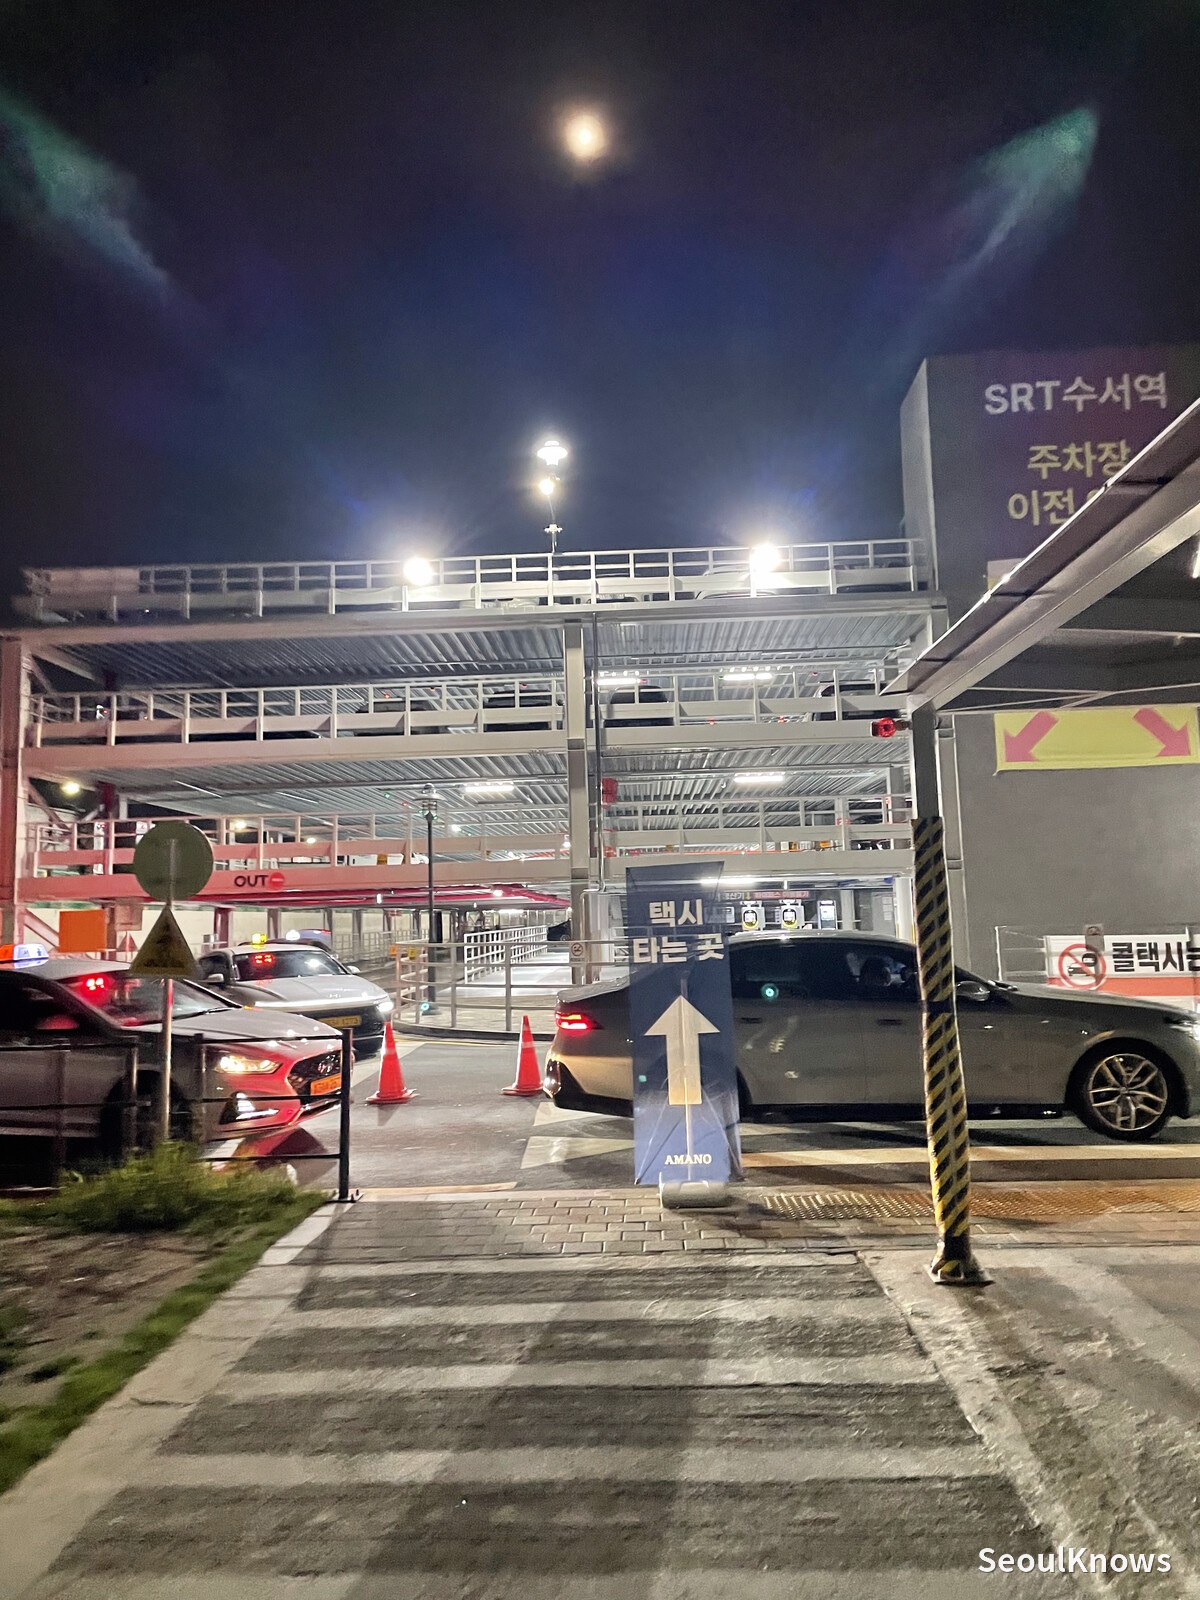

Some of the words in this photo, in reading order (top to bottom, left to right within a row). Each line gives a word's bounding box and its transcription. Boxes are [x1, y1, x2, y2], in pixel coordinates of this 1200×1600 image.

[1027, 439, 1131, 480] 주차장
[1007, 487, 1076, 526] 이전
[234, 874, 269, 887] OUT
[649, 899, 703, 927] 택시
[633, 936, 688, 963] 타는
[697, 933, 724, 960] 곳
[664, 1153, 712, 1165] AMANO
